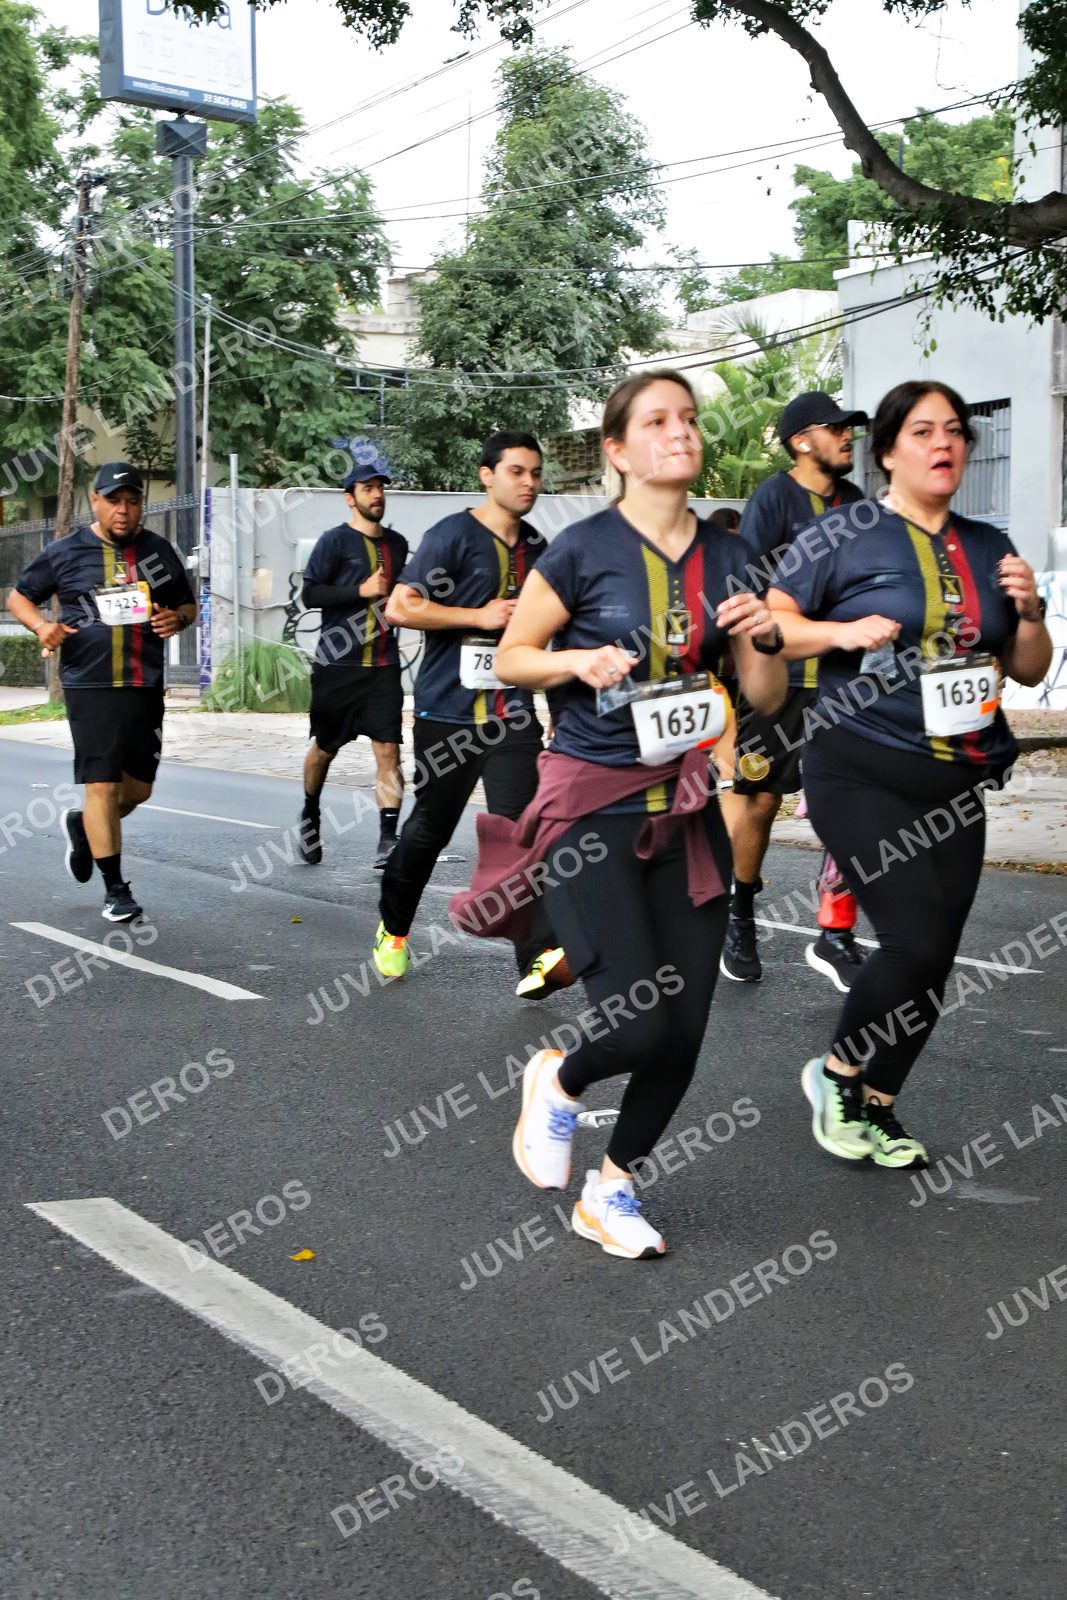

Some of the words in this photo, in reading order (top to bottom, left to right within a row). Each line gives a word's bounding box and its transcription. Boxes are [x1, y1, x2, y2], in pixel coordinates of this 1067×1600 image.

[105, 597, 139, 611] 7425
[473, 653, 494, 671] 78
[936, 677, 990, 708] 1639
[650, 701, 711, 739] 1637
